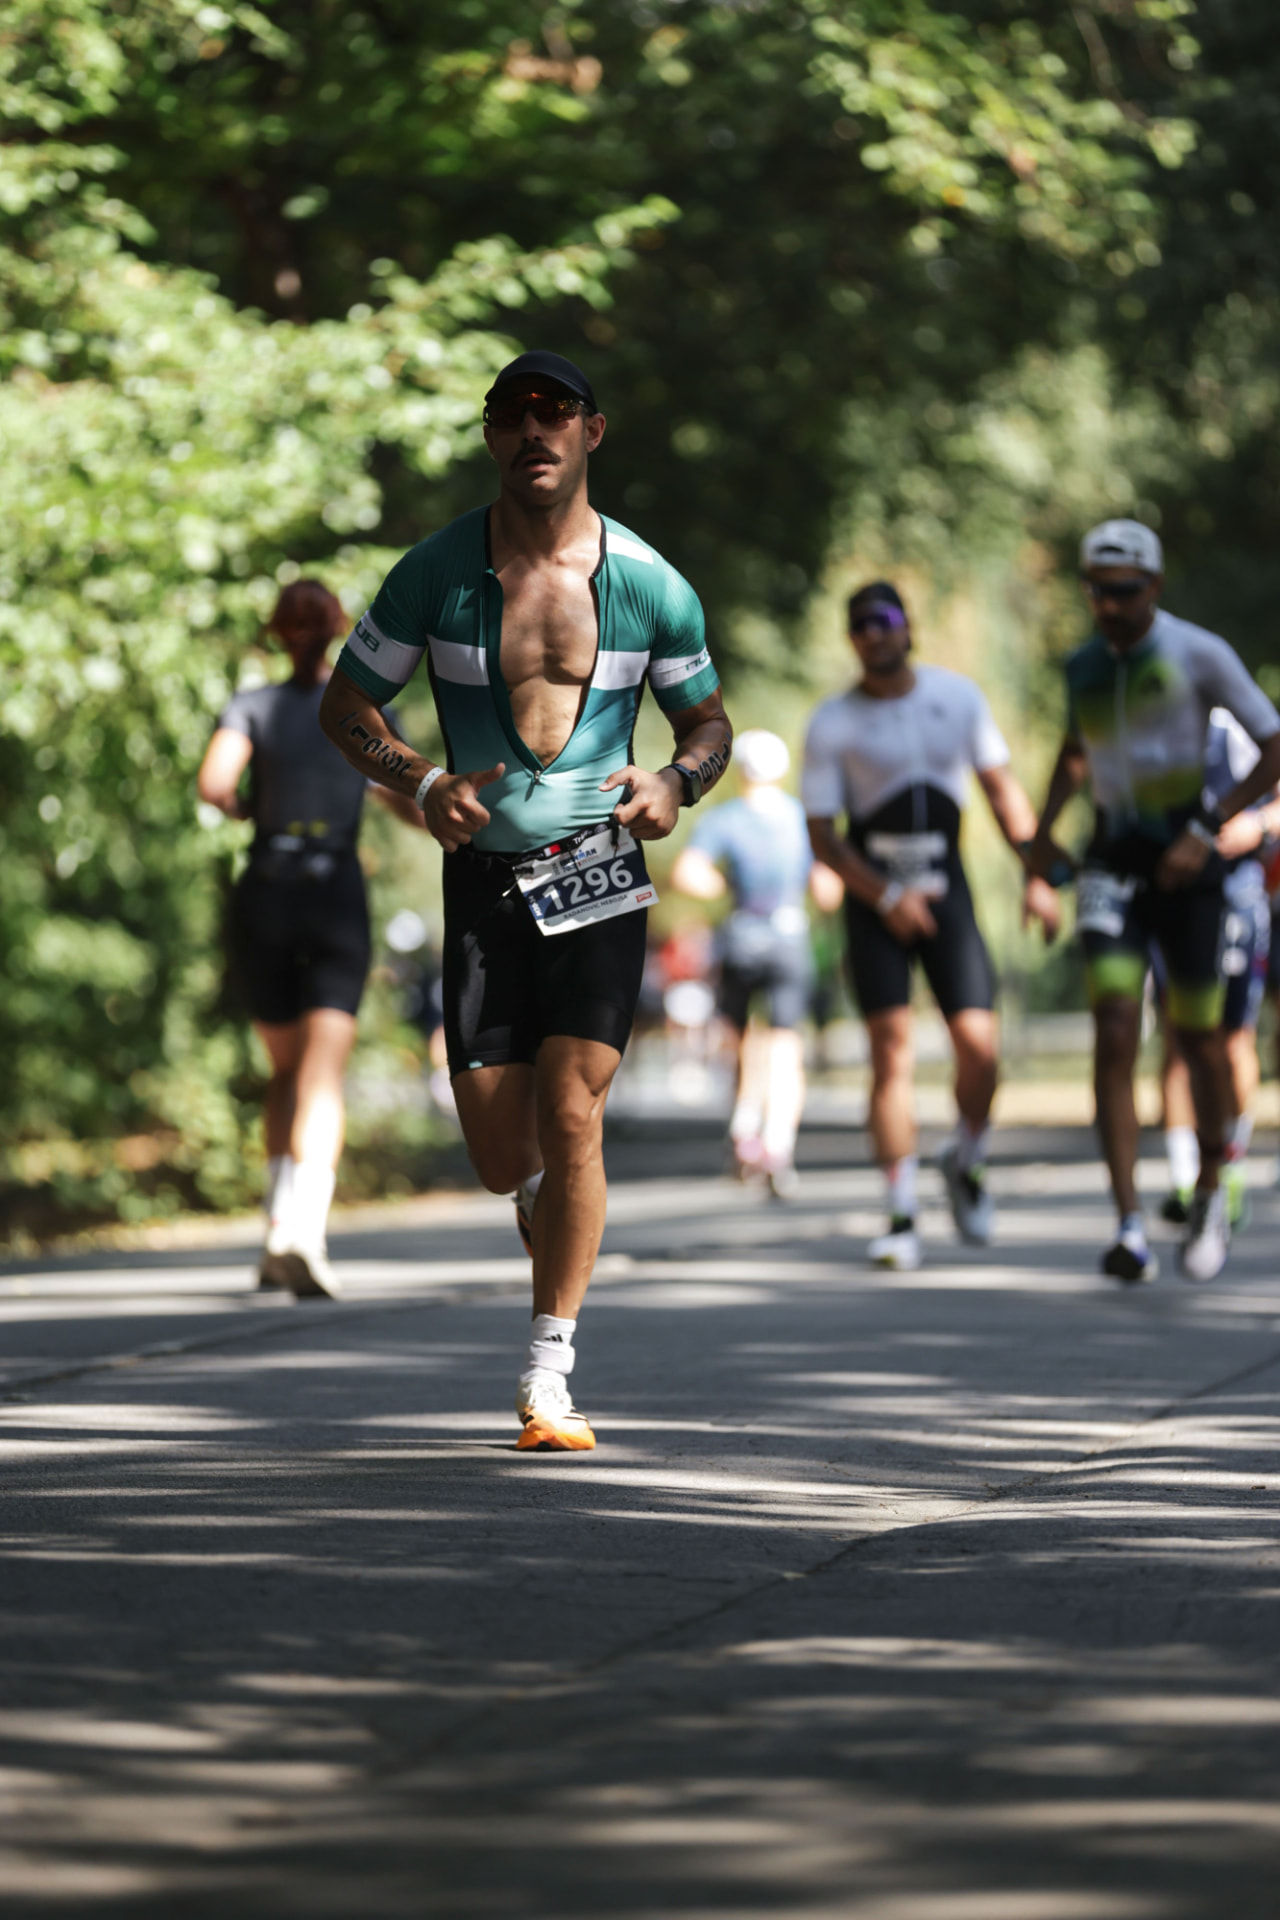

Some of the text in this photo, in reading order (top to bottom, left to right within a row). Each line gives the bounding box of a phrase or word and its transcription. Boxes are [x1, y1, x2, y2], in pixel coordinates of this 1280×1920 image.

[694, 741, 729, 784] 129
[542, 858, 633, 910] 1296
[564, 902, 600, 919] RADANOVIC
